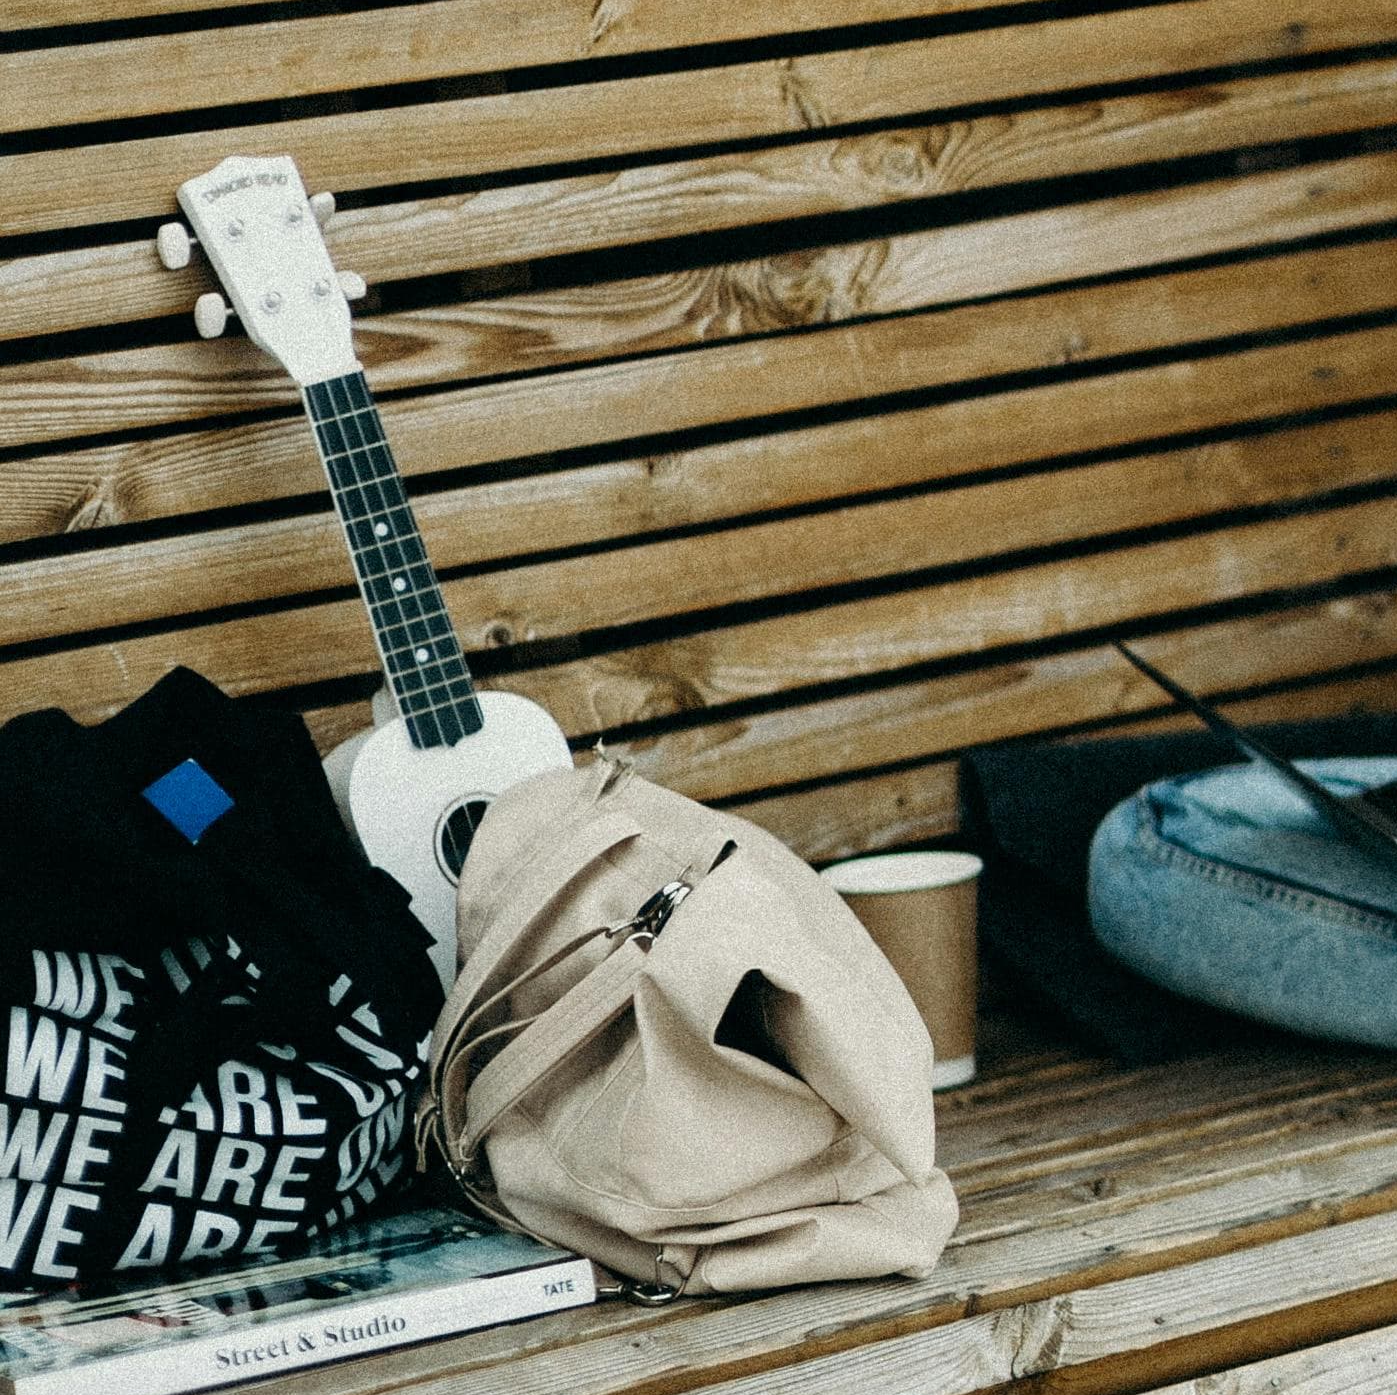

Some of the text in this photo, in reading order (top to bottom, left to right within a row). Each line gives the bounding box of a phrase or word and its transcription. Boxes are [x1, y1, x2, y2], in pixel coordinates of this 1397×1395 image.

[32, 949, 145, 1042] WE
[5, 1006, 128, 1115] WE
[0, 1103, 123, 1187] WE
[138, 1128, 326, 1211] ARE
[216, 1280, 575, 1371] Street & Studio TATE
